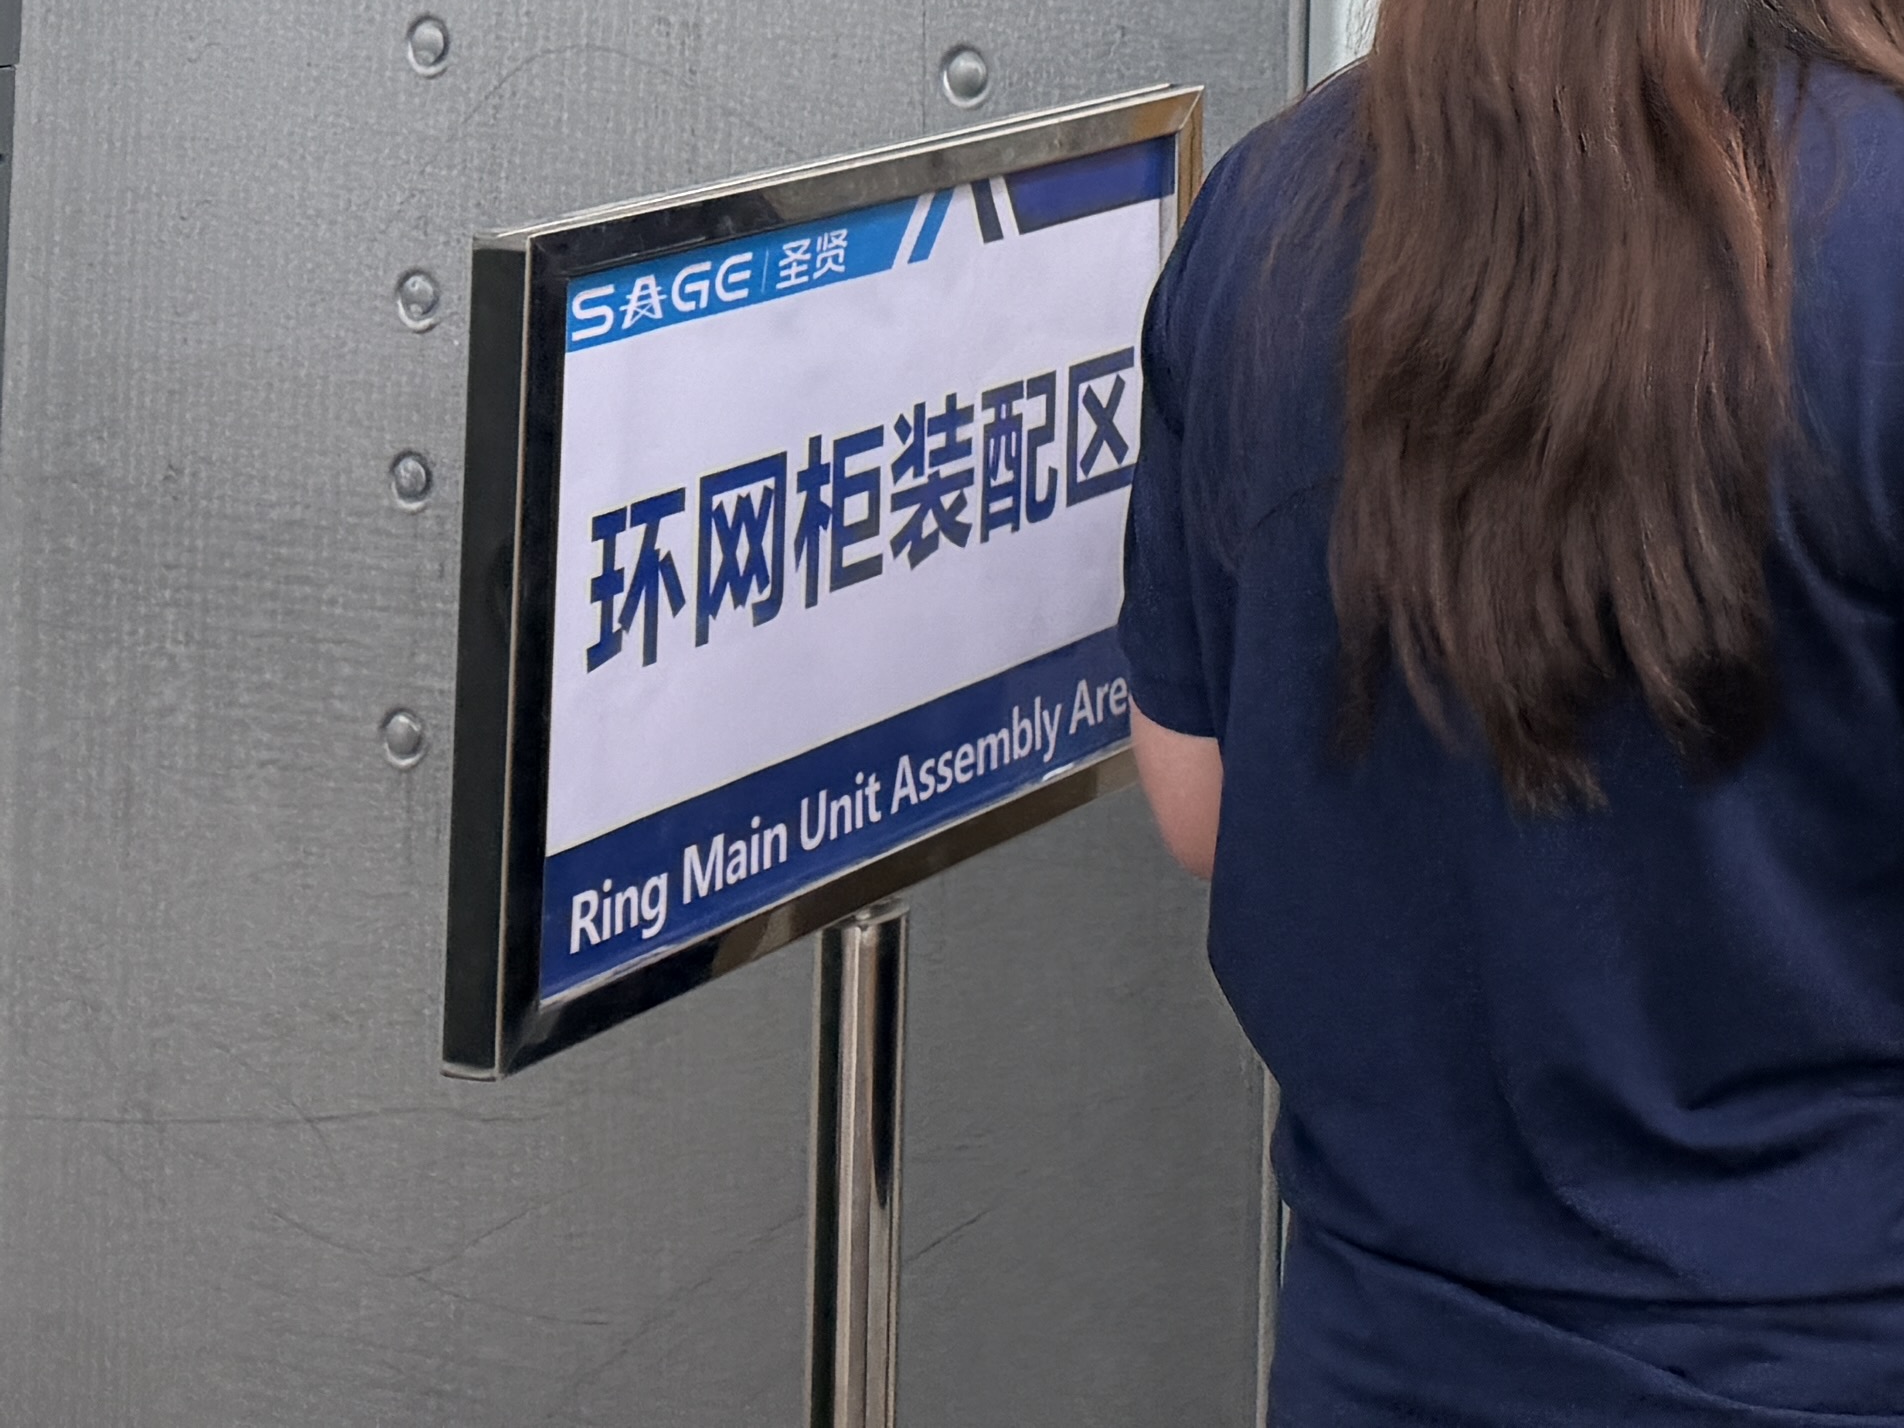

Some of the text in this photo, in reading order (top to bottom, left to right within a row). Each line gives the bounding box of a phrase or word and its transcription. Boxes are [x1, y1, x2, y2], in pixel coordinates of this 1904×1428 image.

[571, 229, 848, 342] SAGE 圣贤
[586, 346, 1136, 674] 环网柜装配区
[569, 675, 1131, 954] Ring Main Unit Assembly Are
